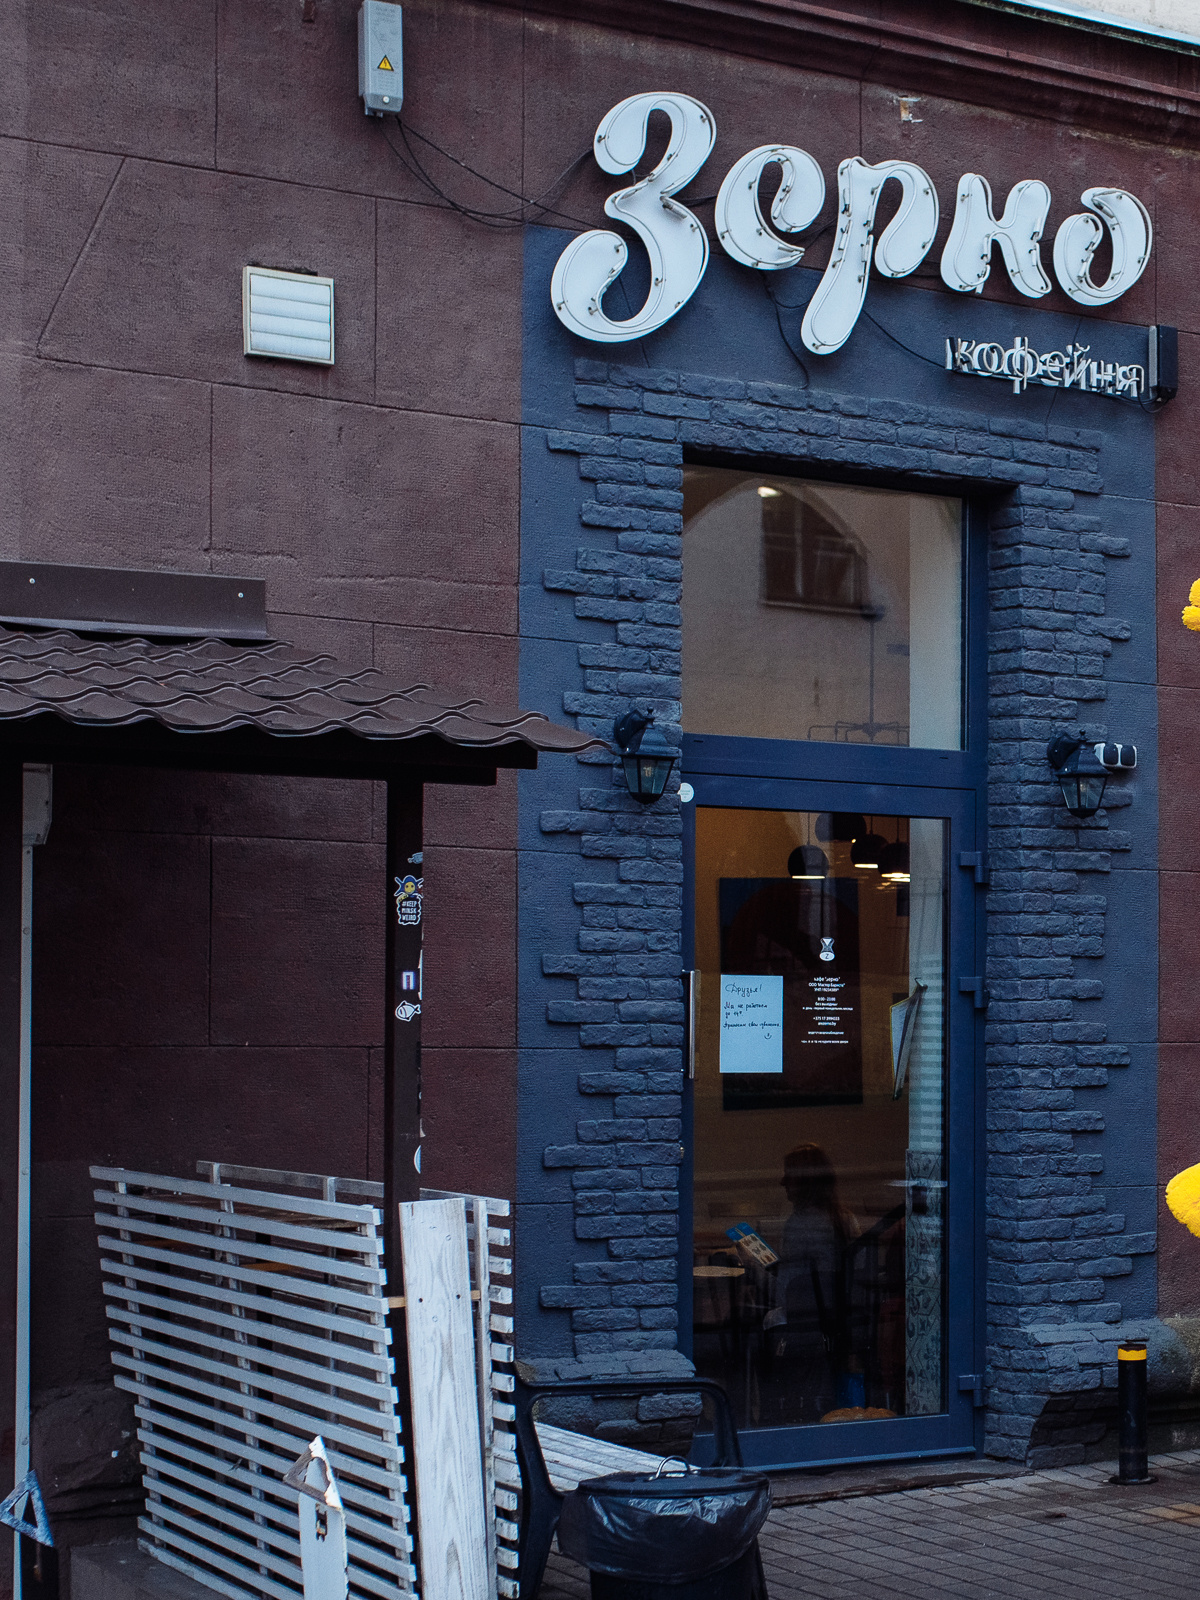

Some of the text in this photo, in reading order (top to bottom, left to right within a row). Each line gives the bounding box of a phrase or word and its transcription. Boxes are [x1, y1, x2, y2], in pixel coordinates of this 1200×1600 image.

[551, 91, 1153, 355] Зерно
[945, 336, 1145, 397] кофейня
[724, 982, 763, 998] Друзья!
